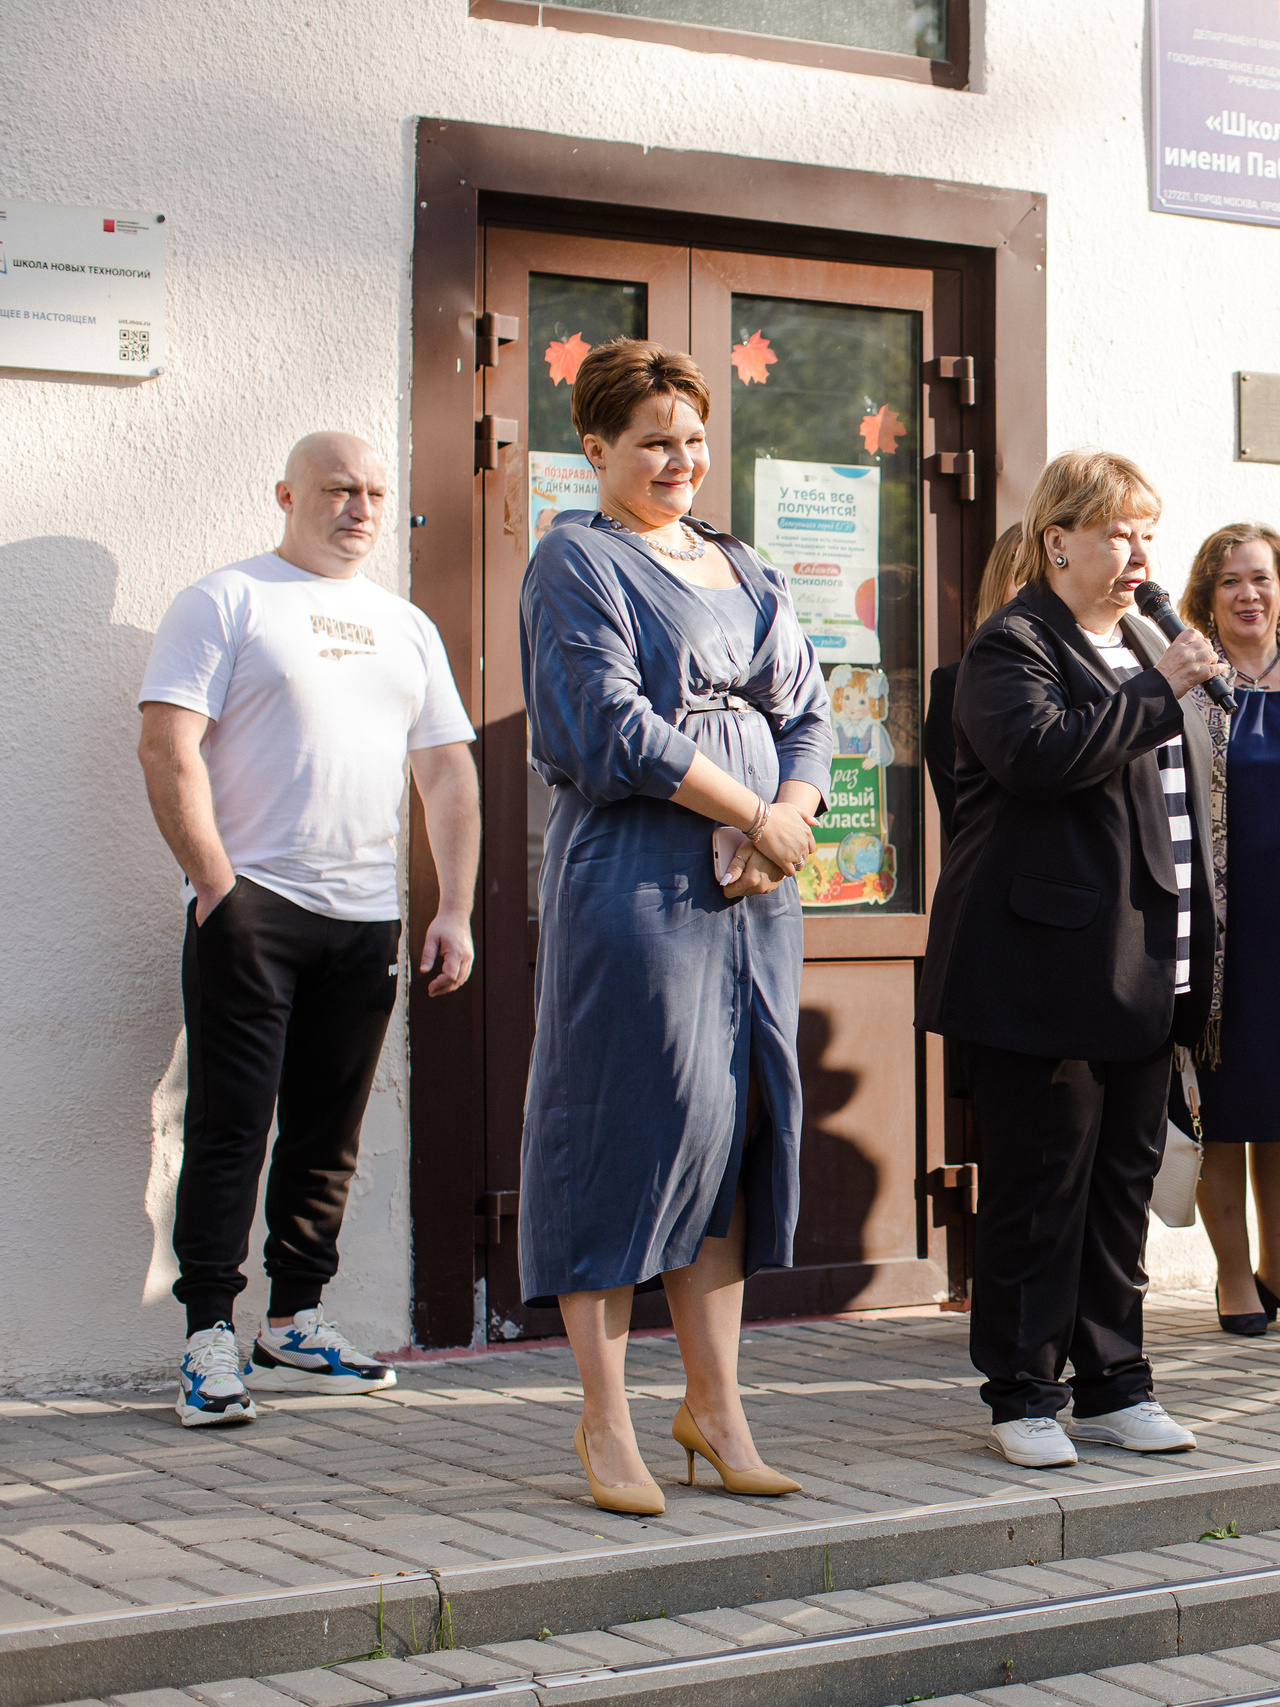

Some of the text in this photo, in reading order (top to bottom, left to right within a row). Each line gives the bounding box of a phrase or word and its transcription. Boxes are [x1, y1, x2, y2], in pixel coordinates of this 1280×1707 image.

[1164, 146, 1241, 175] имени
[13, 258, 151, 279] ШКОЛА НОВЫХ ТЕХНОЛОГИЙ
[24, 310, 30, 319] В
[33, 311, 97, 325] НАСТОЯЩЕМ
[537, 481, 544, 492] С
[779, 486, 854, 504] У тебя все
[777, 502, 856, 517] получится!
[797, 562, 839, 575] Кабинет
[790, 577, 843, 588] психолога
[310, 614, 376, 647] PUMA
[831, 768, 859, 791] раз
[818, 808, 876, 829] класс!
